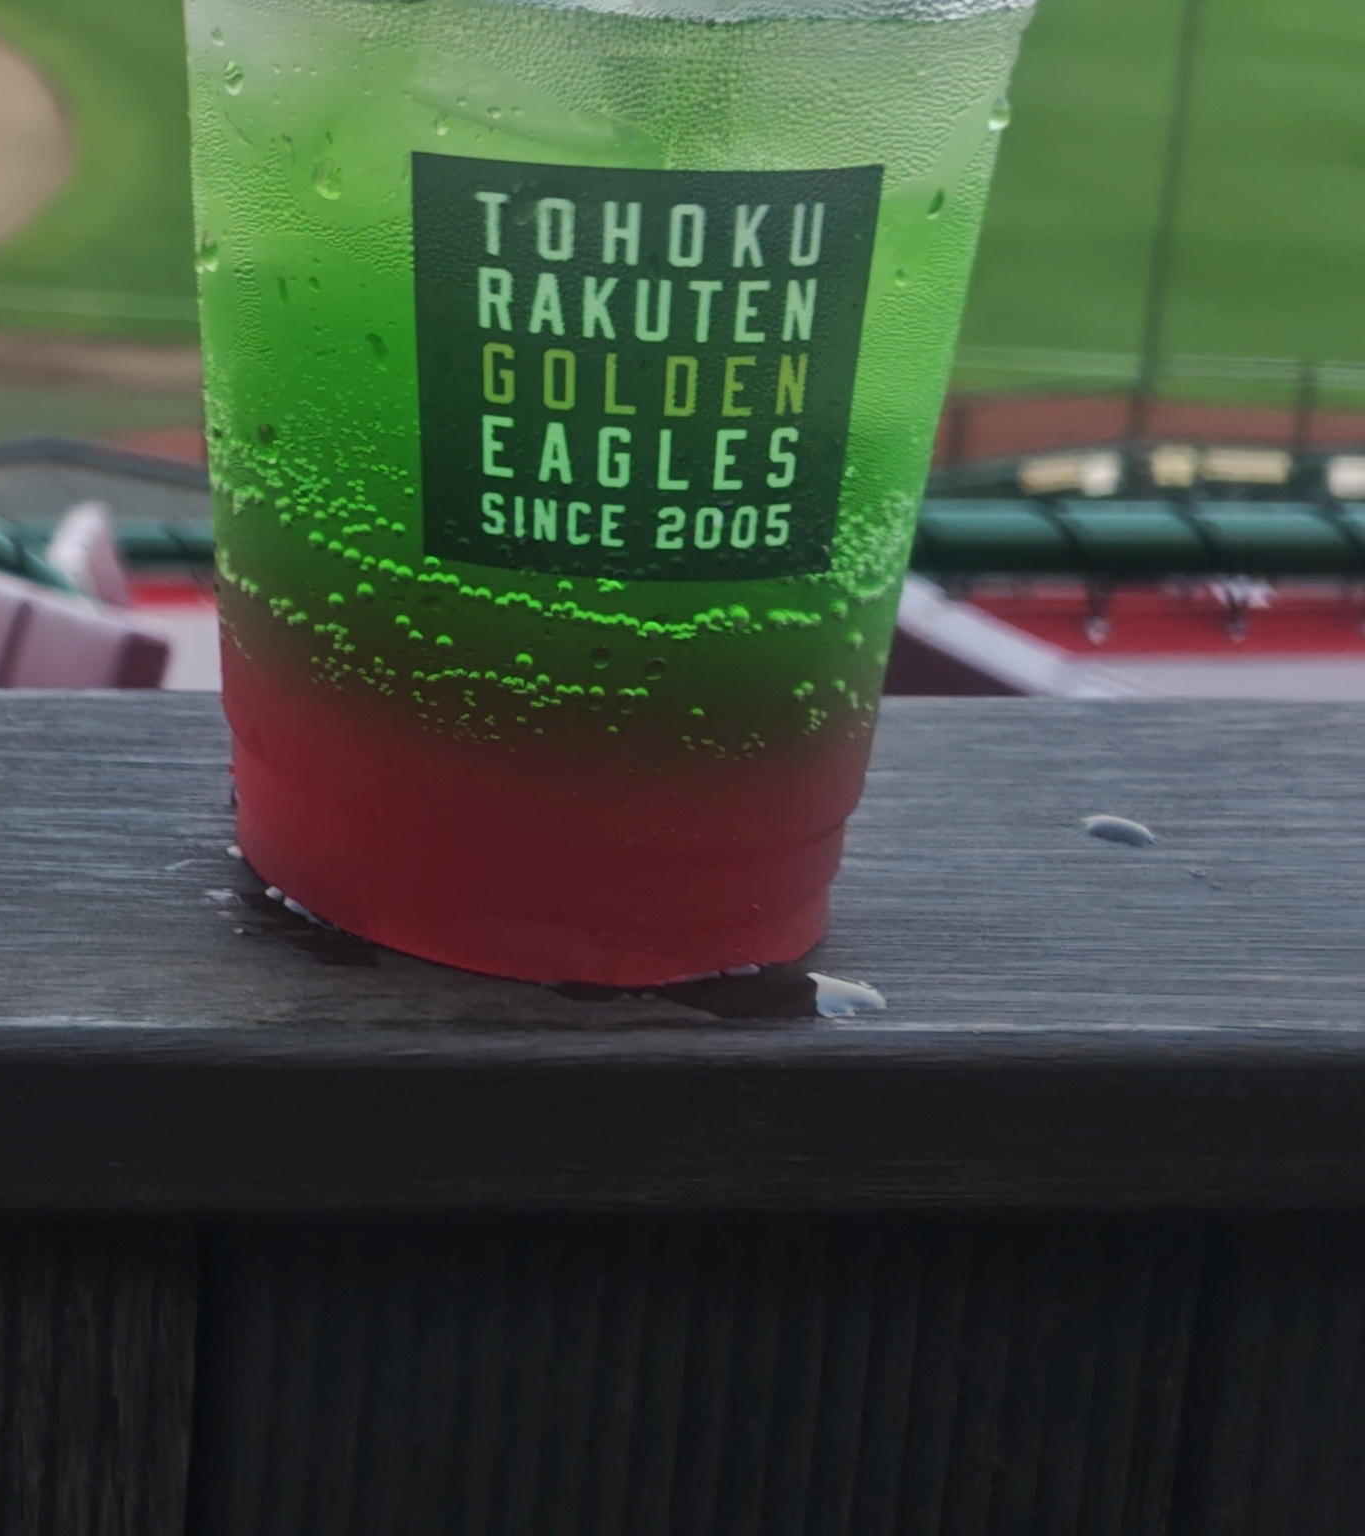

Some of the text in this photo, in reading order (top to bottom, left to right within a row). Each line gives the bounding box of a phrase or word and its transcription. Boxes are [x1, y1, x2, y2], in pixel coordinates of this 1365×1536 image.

[475, 191, 825, 268] TOHOKU
[477, 266, 818, 344] RAKUTEN
[482, 342, 809, 418] GOLDEN
[481, 414, 799, 491] EAGLES
[481, 492, 793, 550] SINCE 2005
